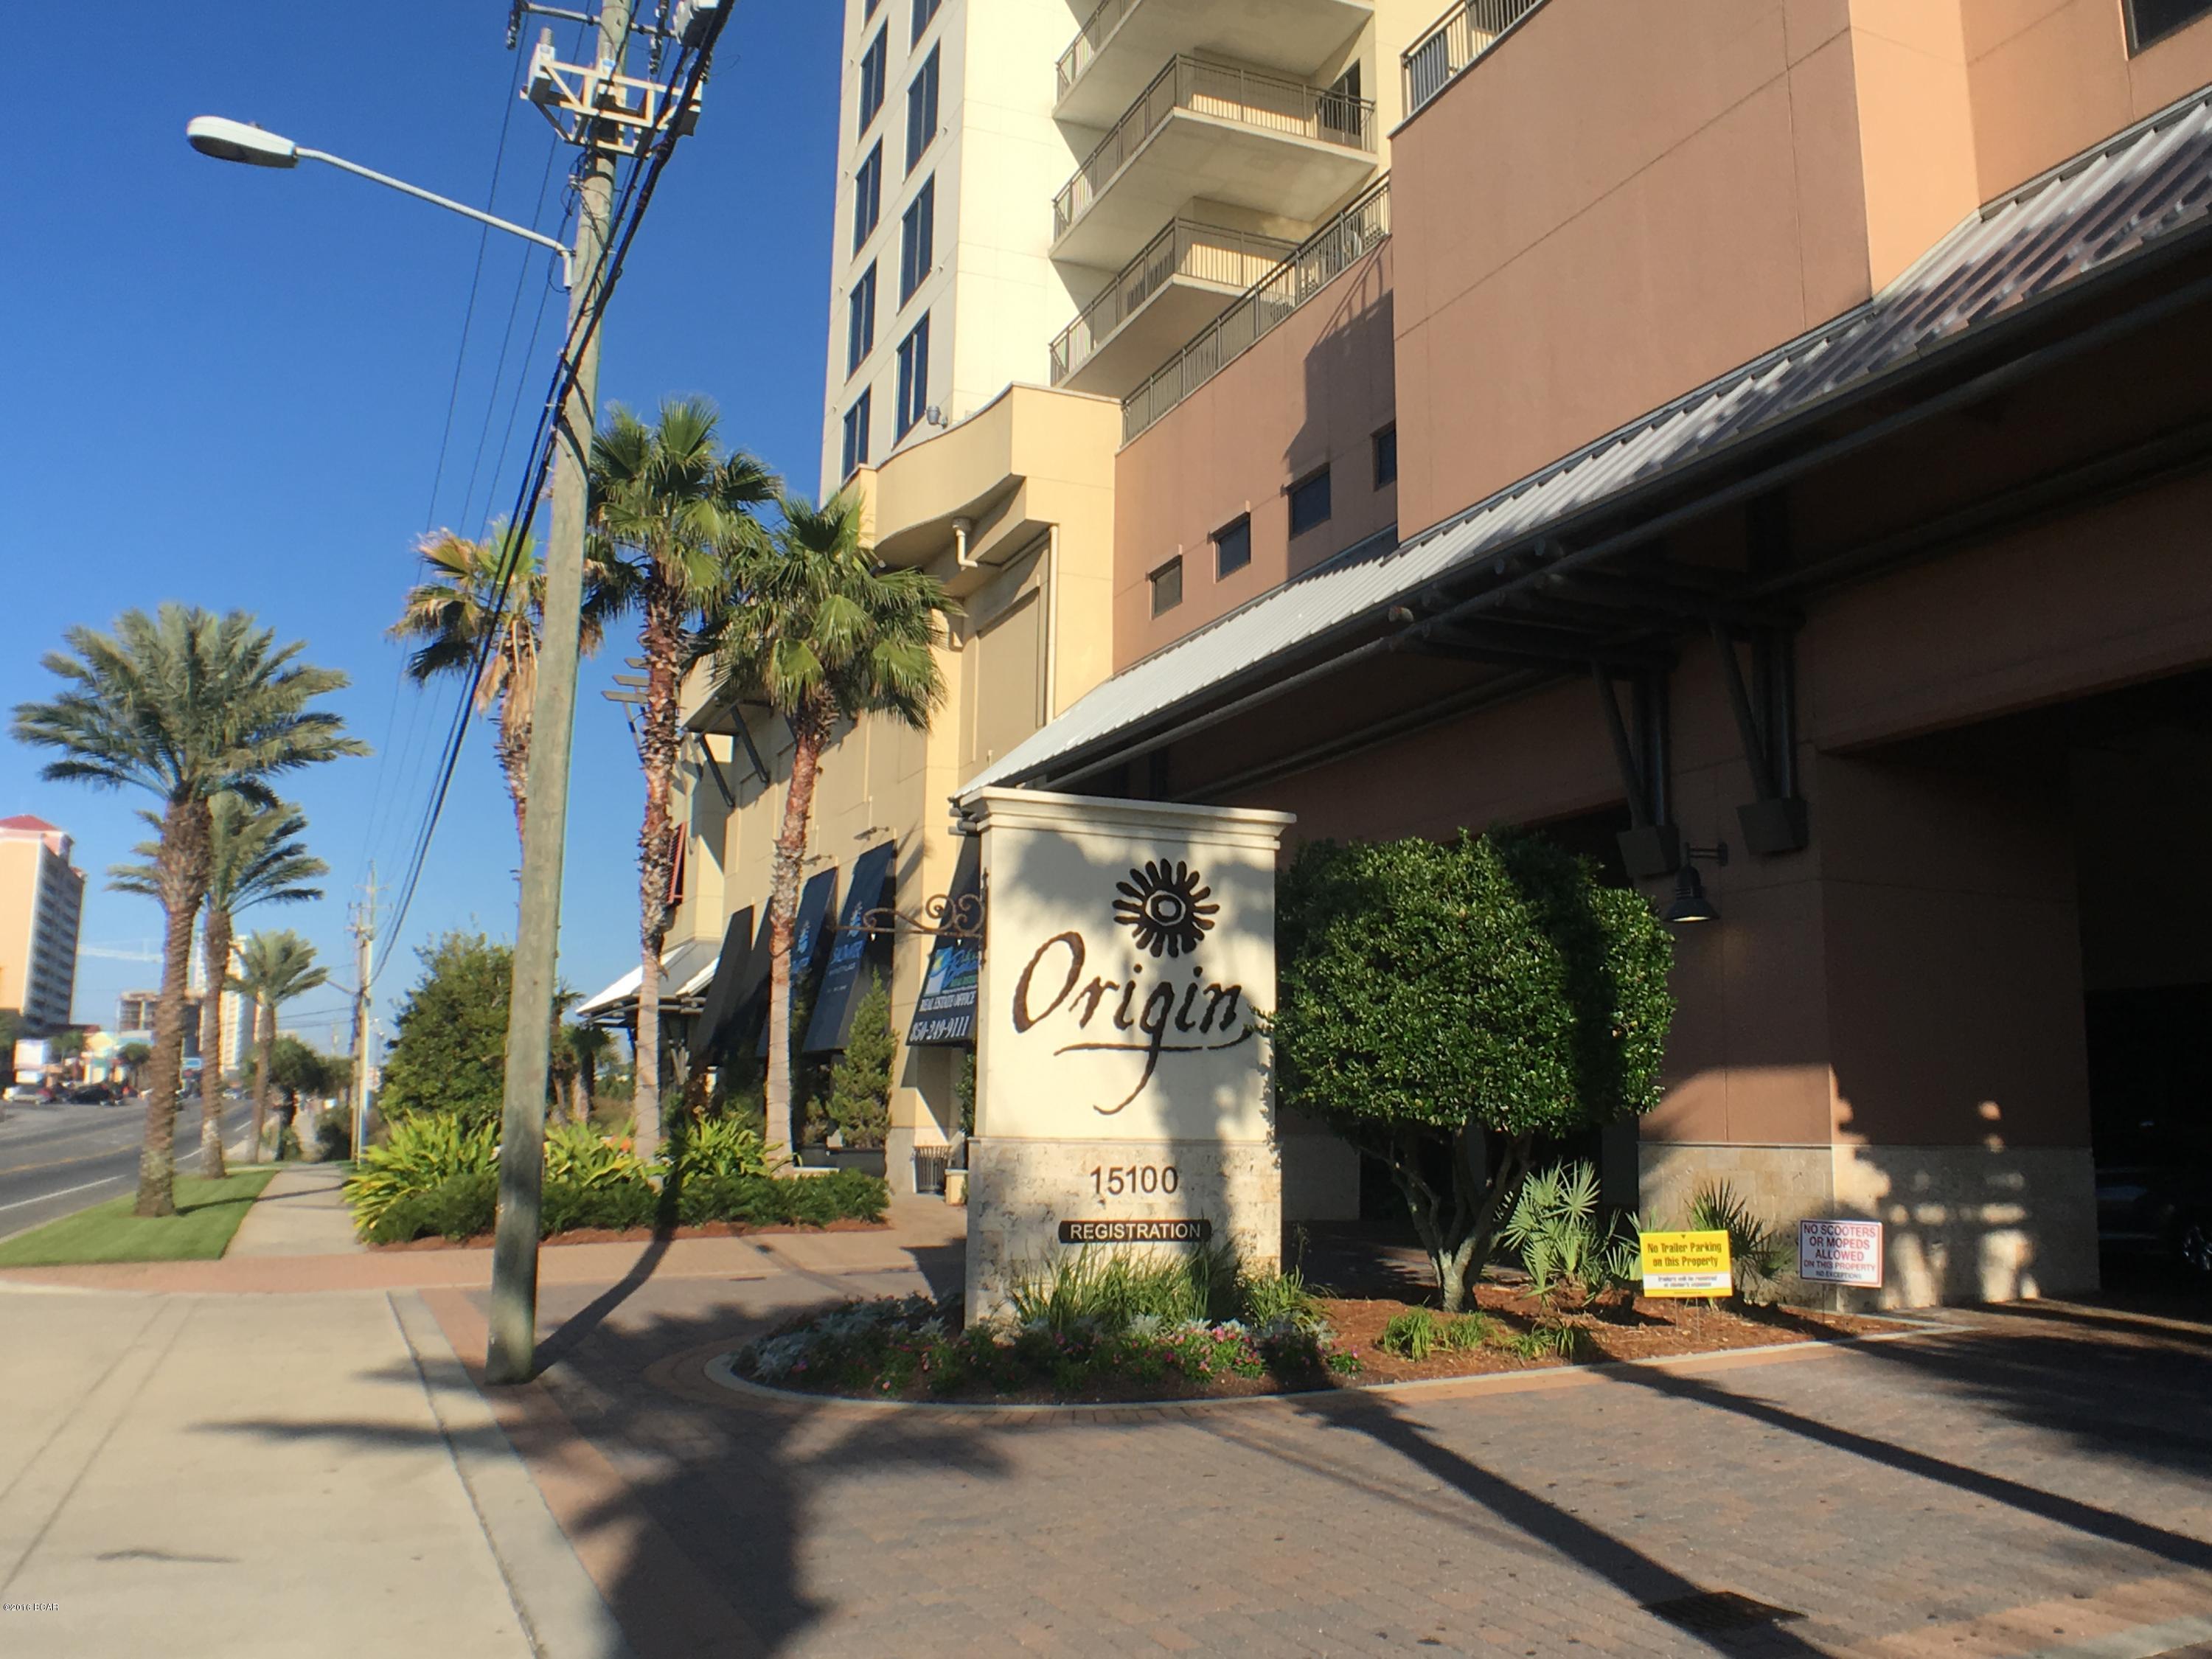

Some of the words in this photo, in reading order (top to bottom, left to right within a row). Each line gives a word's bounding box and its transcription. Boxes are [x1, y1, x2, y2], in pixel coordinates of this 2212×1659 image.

[910, 1015, 970, 1041] 850-249-9111
[1012, 931, 1246, 1116] Origin
[1090, 1165, 1179, 1195] 15100
[1070, 1223, 1201, 1240] REGISTRATION
[1804, 1225, 1818, 1234] NO
[1820, 1225, 1876, 1238] SCOOTERS
[1647, 1243, 1658, 1253] No
[1661, 1242, 1688, 1253] Trailer
[1690, 1242, 1722, 1253] Parking
[1809, 1237, 1823, 1246] OR
[1826, 1237, 1870, 1250] MOPEDS
[1653, 1259, 1662, 1267] on
[1665, 1256, 1680, 1267] this
[1682, 1256, 1718, 1267] Property
[1815, 1249, 1864, 1261] ALLOWED
[1804, 1259, 1815, 1267] ON
[1817, 1260, 1833, 1269] THIS
[1834, 1262, 1876, 1271] PROPERTY
[1826, 1270, 1862, 1279] EXCEPTIONS
